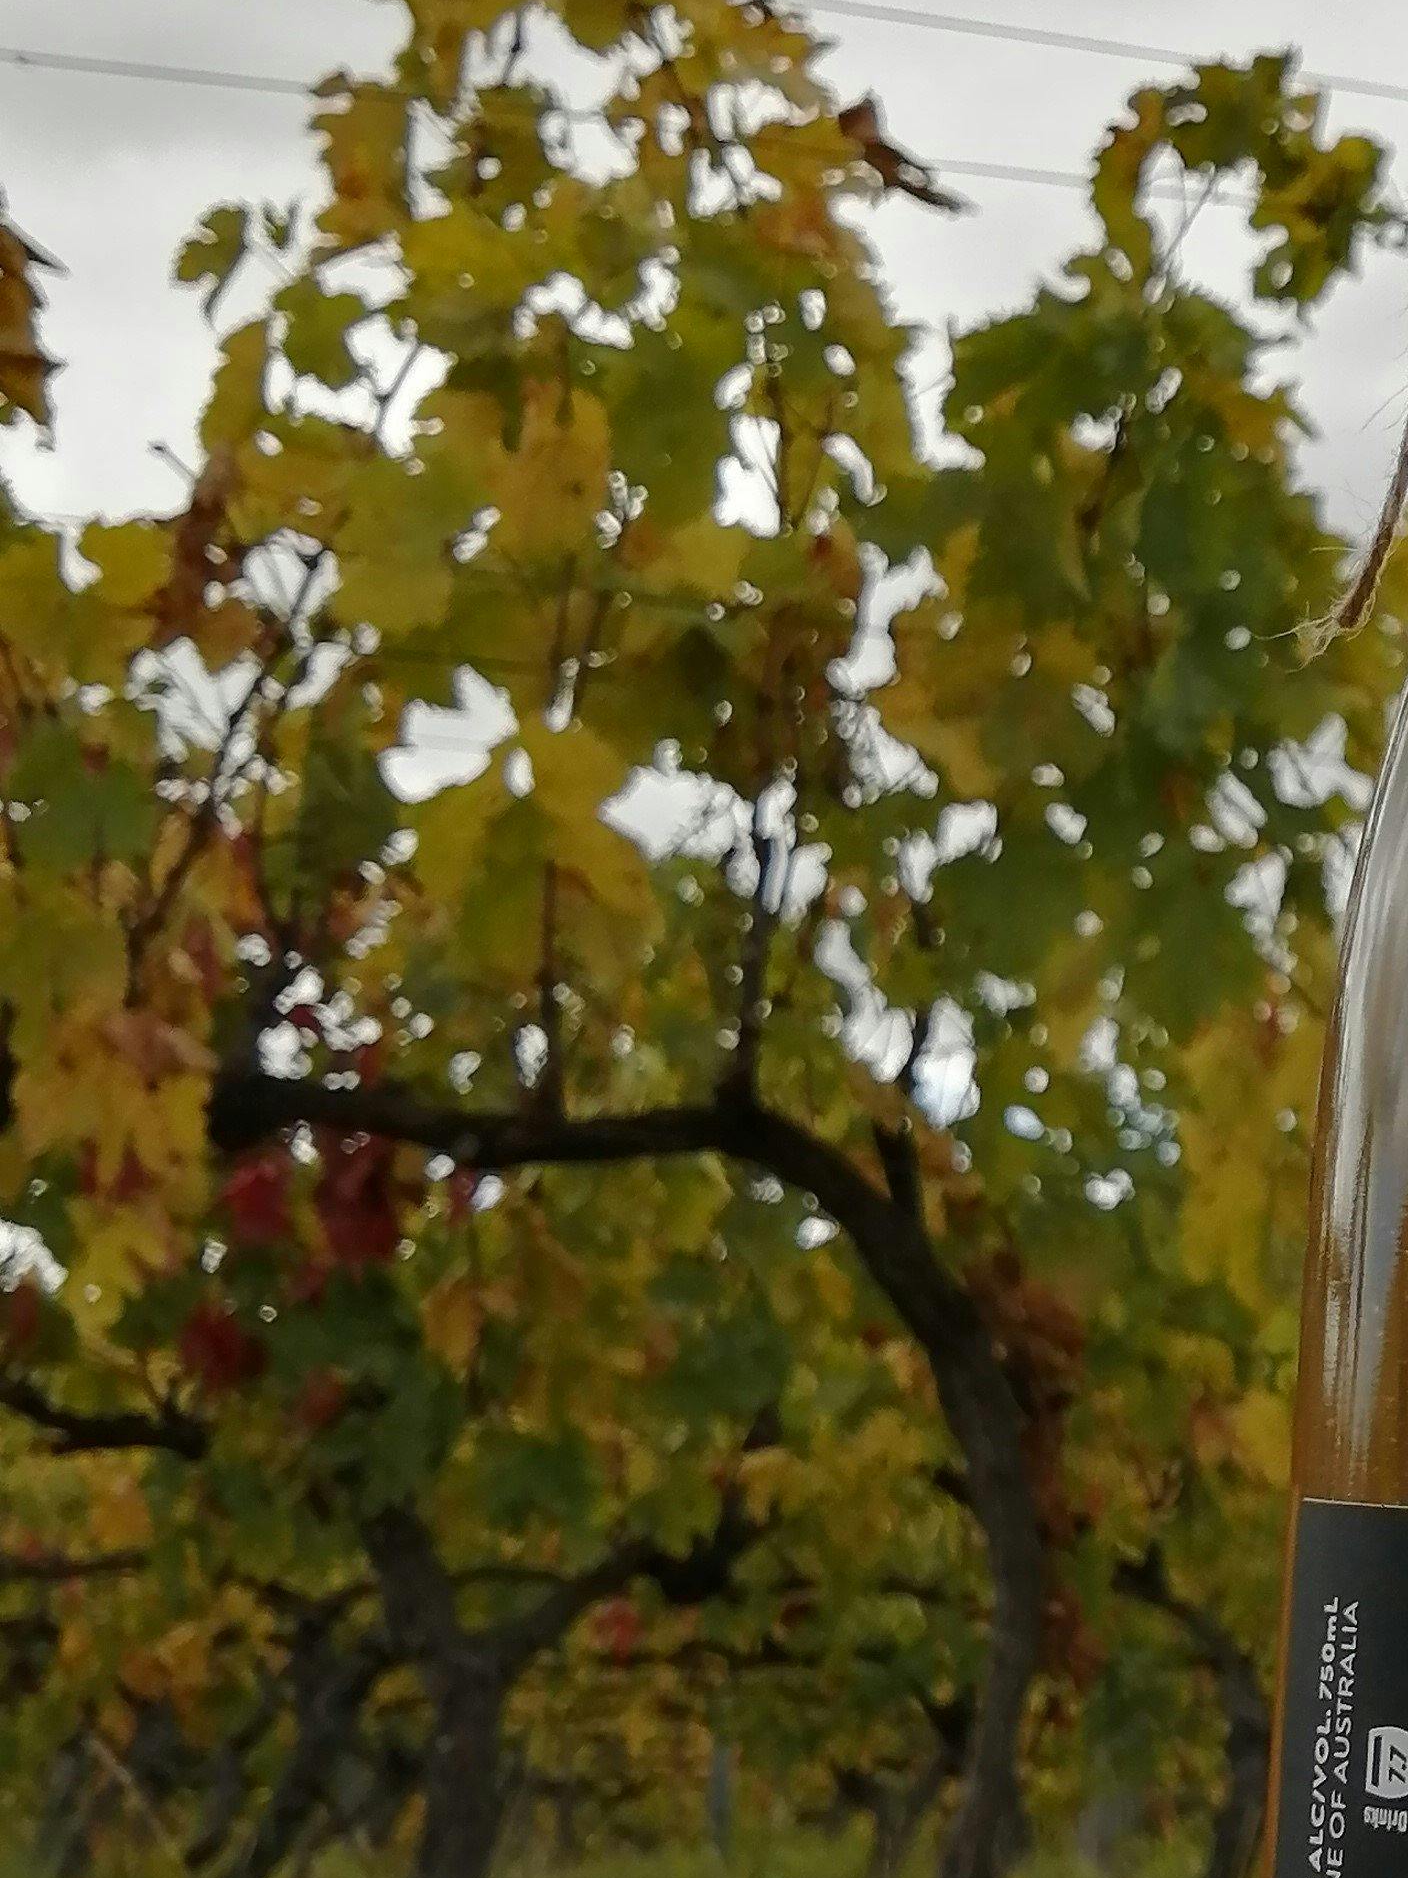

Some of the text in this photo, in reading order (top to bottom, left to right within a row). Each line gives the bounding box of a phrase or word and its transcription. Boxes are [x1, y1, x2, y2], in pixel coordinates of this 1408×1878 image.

[1318, 1596, 1339, 1700] 750mL
[1333, 1600, 1359, 1785] AUSTRALIA
[1307, 1709, 1332, 1873] ALC/VOL.
[1328, 1789, 1347, 1840] OF
